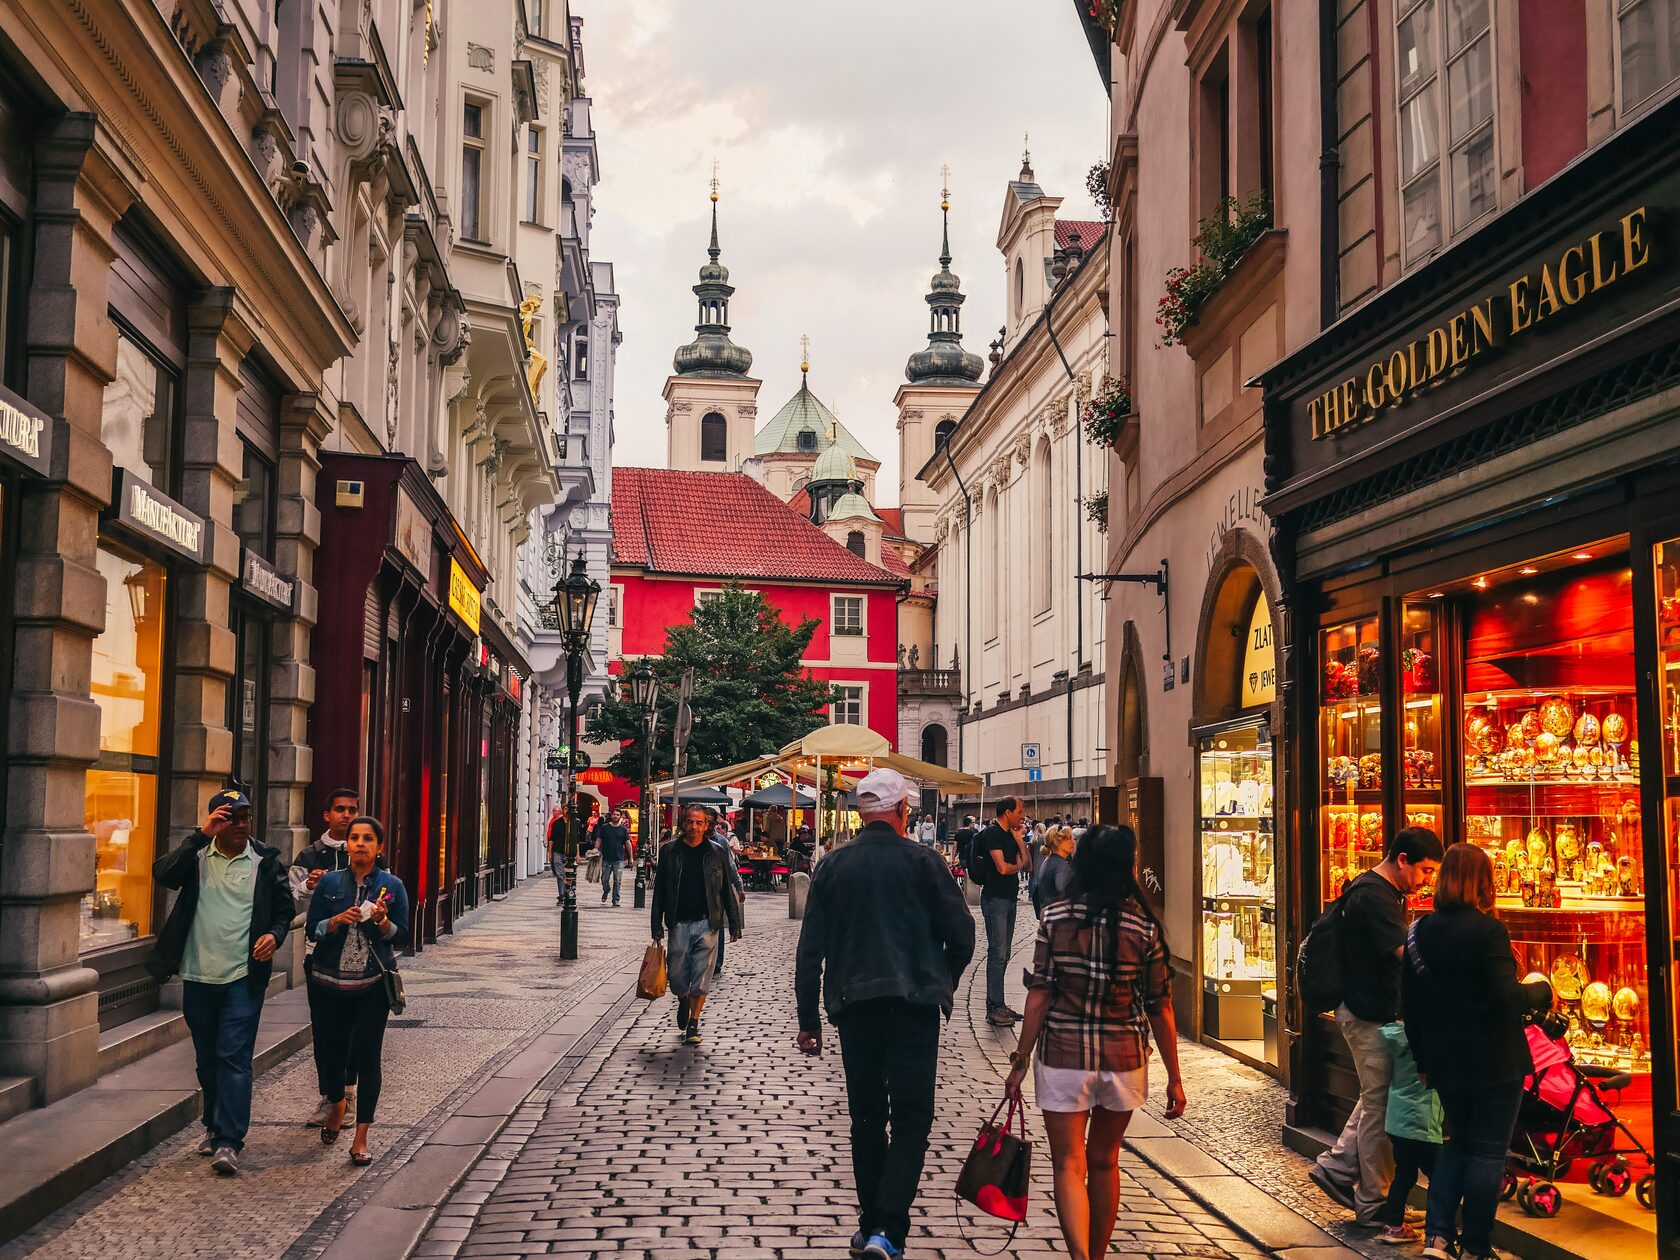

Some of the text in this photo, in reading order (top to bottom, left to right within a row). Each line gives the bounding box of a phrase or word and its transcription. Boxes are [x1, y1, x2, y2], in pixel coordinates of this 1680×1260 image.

[1307, 206, 1650, 441] THE GOLDEN EAGLE
